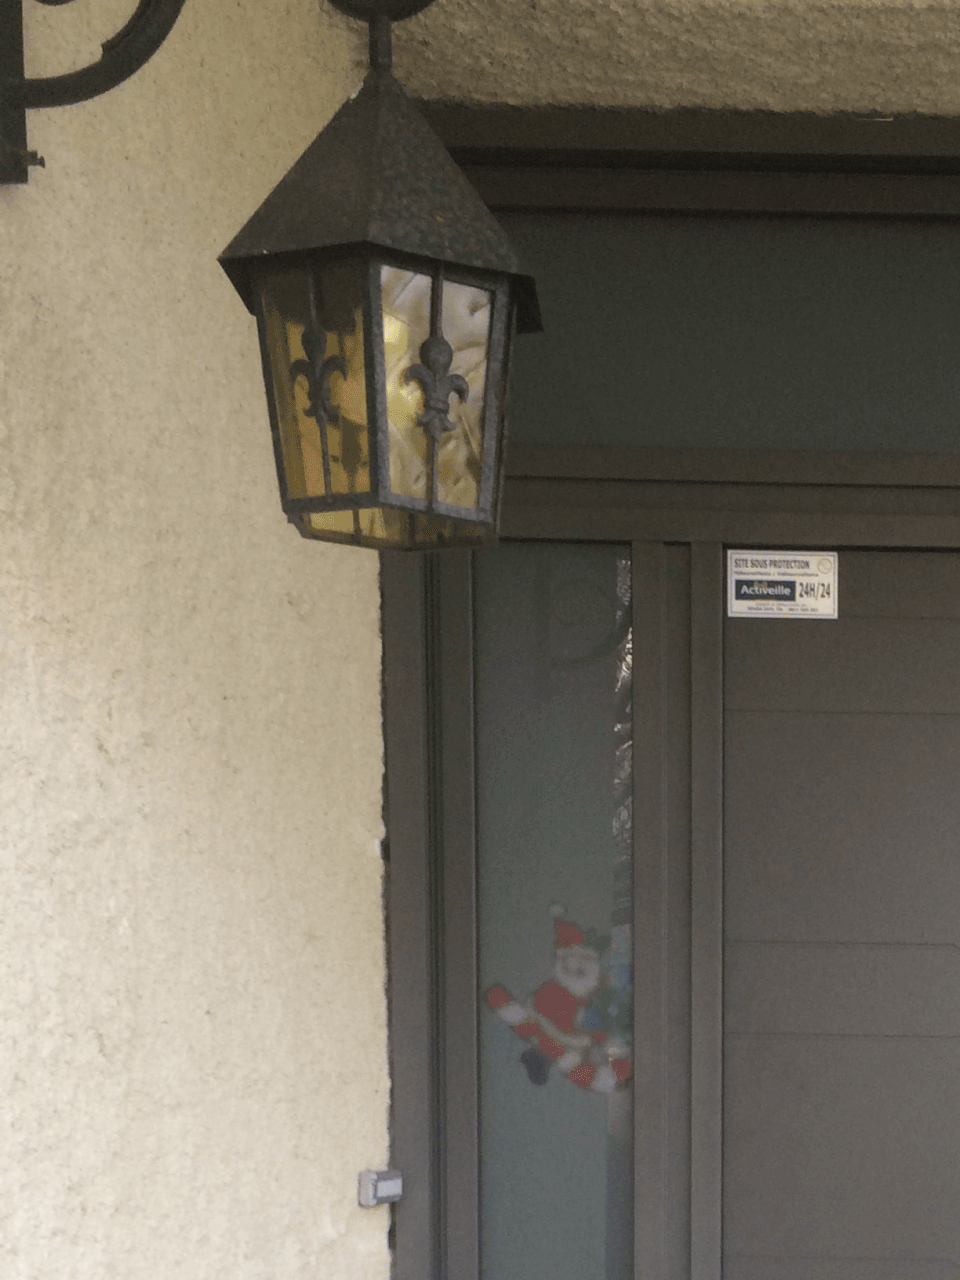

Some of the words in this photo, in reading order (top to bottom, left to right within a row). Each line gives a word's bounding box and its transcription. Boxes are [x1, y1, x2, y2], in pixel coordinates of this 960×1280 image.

[734, 558, 749, 569] SITE
[750, 558, 768, 569] SOUS
[769, 559, 810, 569] PROTECTION
[740, 584, 791, 596] Activeille
[799, 582, 831, 600] 24H/24
